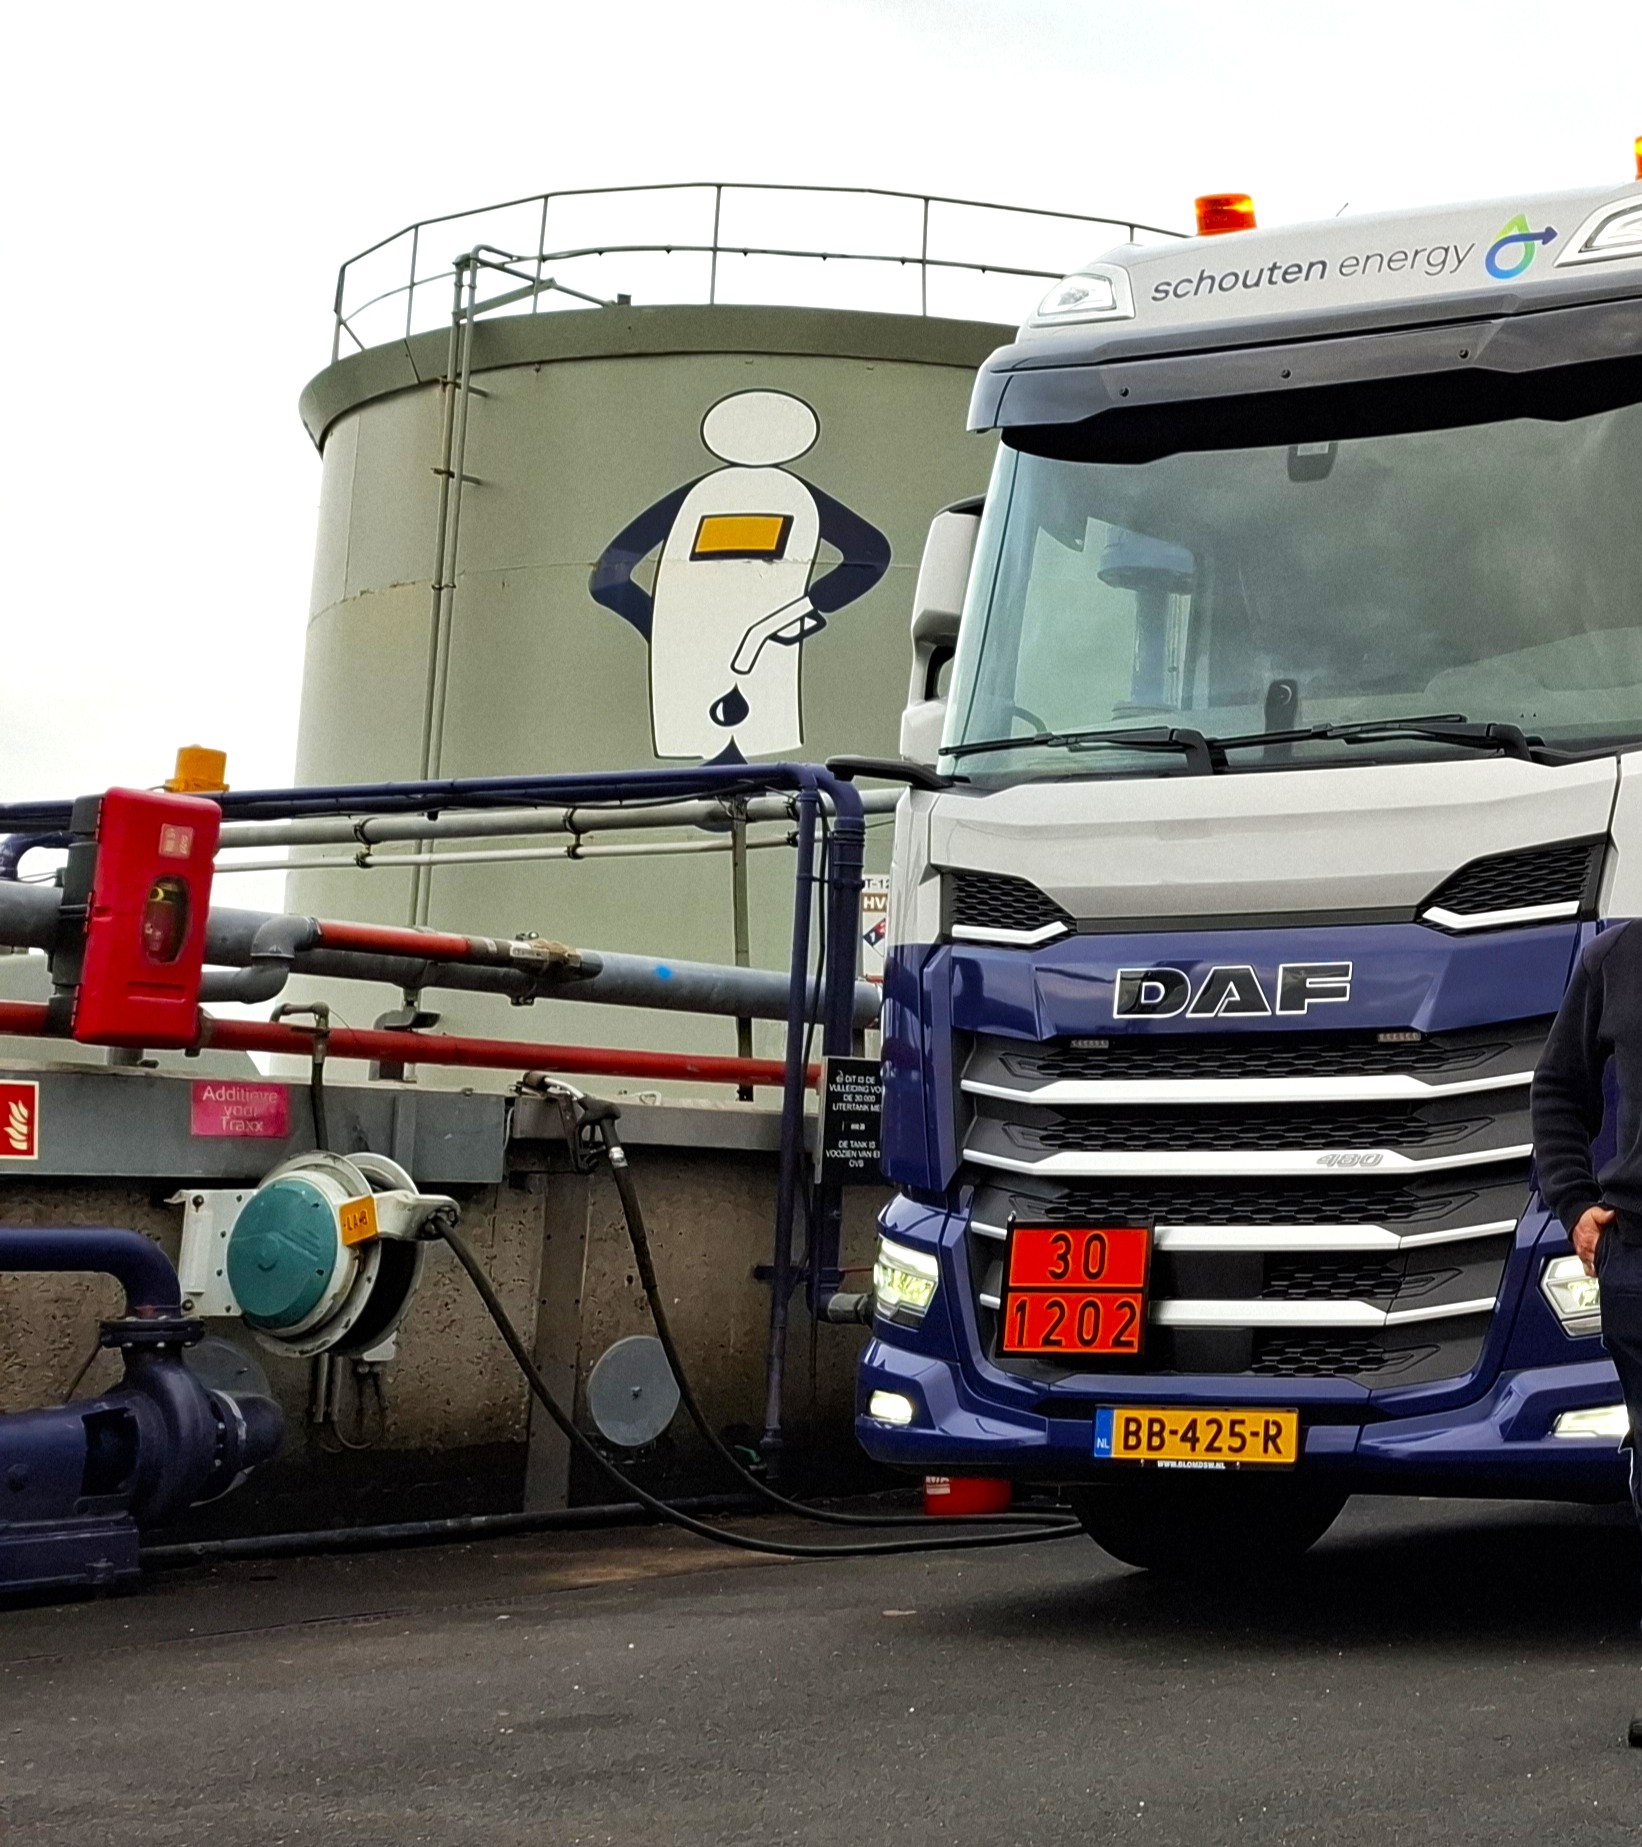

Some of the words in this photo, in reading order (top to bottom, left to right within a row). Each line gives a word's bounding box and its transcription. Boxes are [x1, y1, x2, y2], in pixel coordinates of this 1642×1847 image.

[1151, 258, 1328, 302] schouten
[1338, 242, 1476, 277] energy
[863, 896, 889, 910] HV
[1113, 960, 1354, 1020] DAF
[1316, 1153, 1384, 1168] 480
[1048, 1231, 1108, 1281] 30
[1014, 1299, 1138, 1348] 1202
[1096, 1436, 1111, 1449] NL
[1122, 1416, 1284, 1455] BB-425-R
